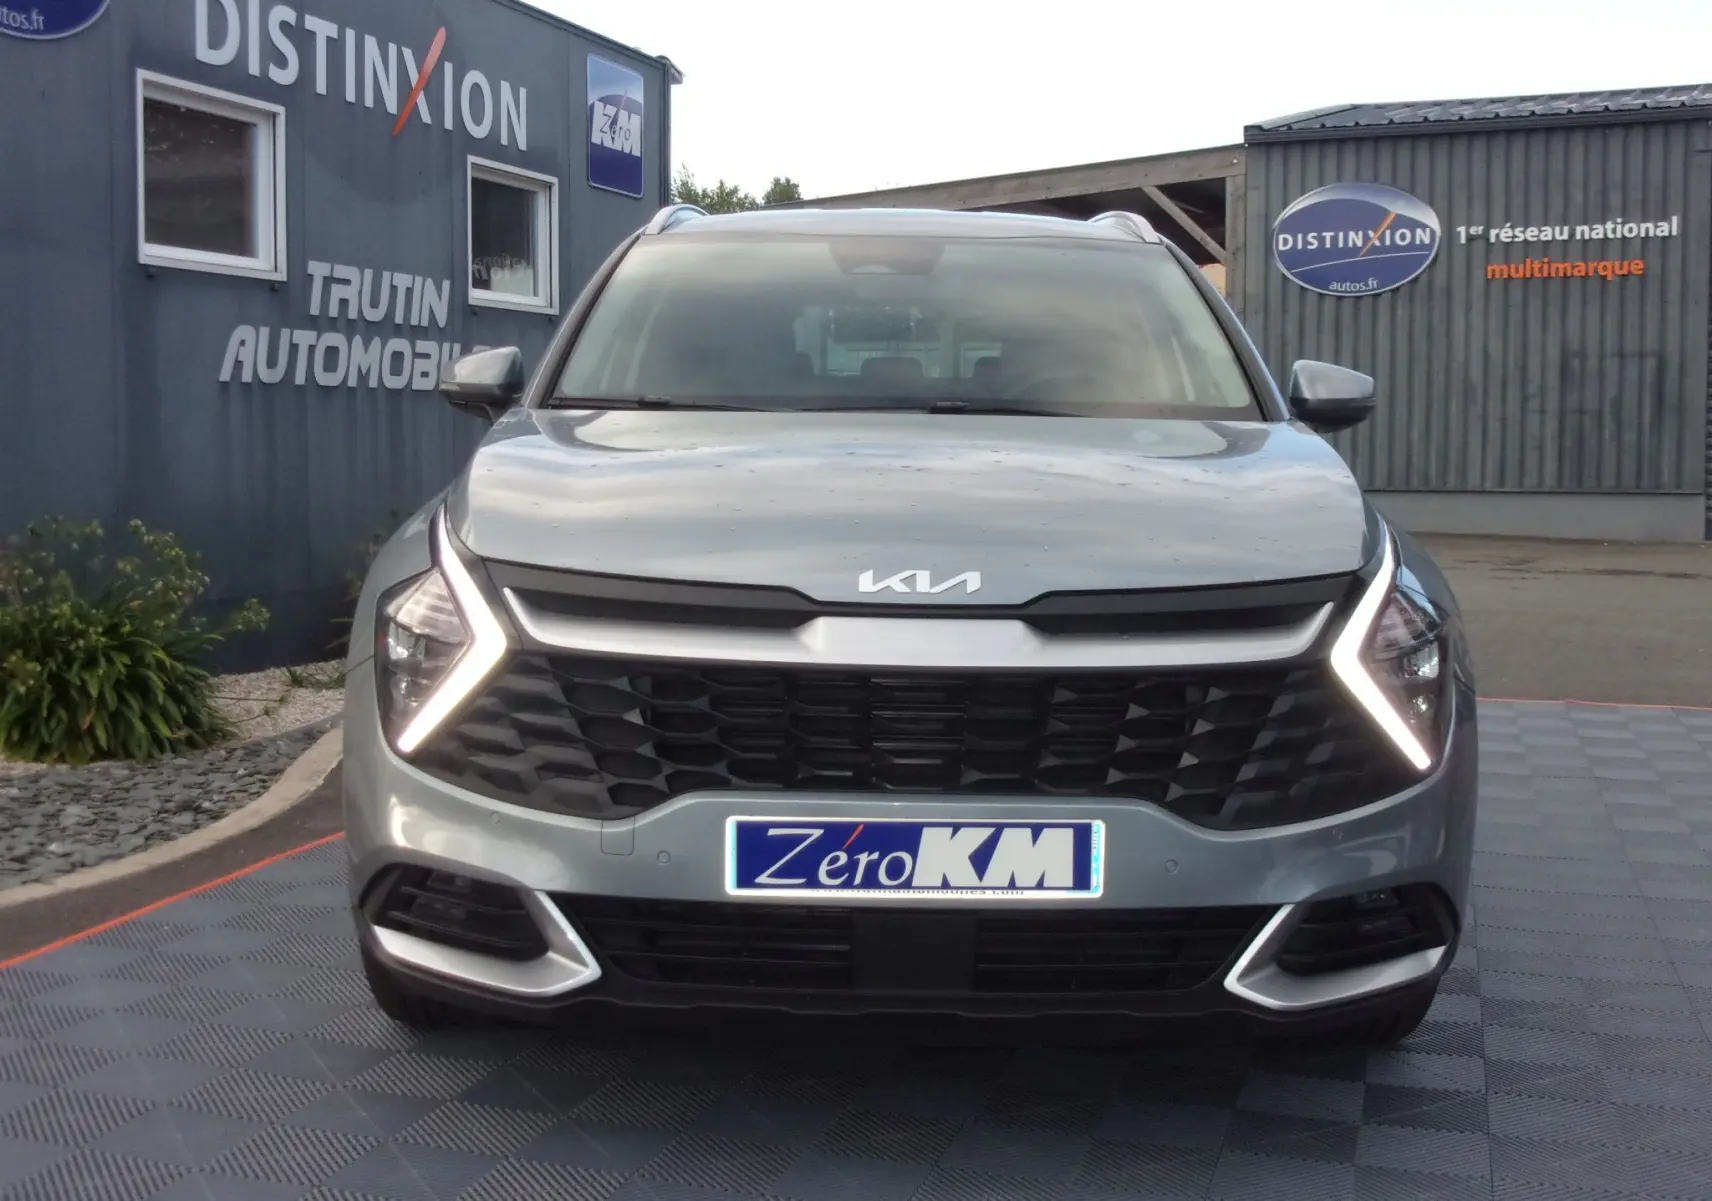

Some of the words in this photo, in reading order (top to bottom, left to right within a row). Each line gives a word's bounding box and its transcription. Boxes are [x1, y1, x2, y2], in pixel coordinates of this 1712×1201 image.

[0, 7, 45, 30] tos.fr
[194, 0, 528, 151] DISTINXION
[591, 100, 641, 158] KM
[1277, 211, 1431, 257] DISTINXION
[1489, 222, 1569, 244] réseau
[1575, 215, 1679, 241] national
[1328, 277, 1379, 292] autos.fr
[1486, 257, 1645, 281] multimarque
[306, 260, 450, 329] TRUTIN
[218, 324, 492, 391] AUTOMOBI
[858, 569, 982, 594] KIA
